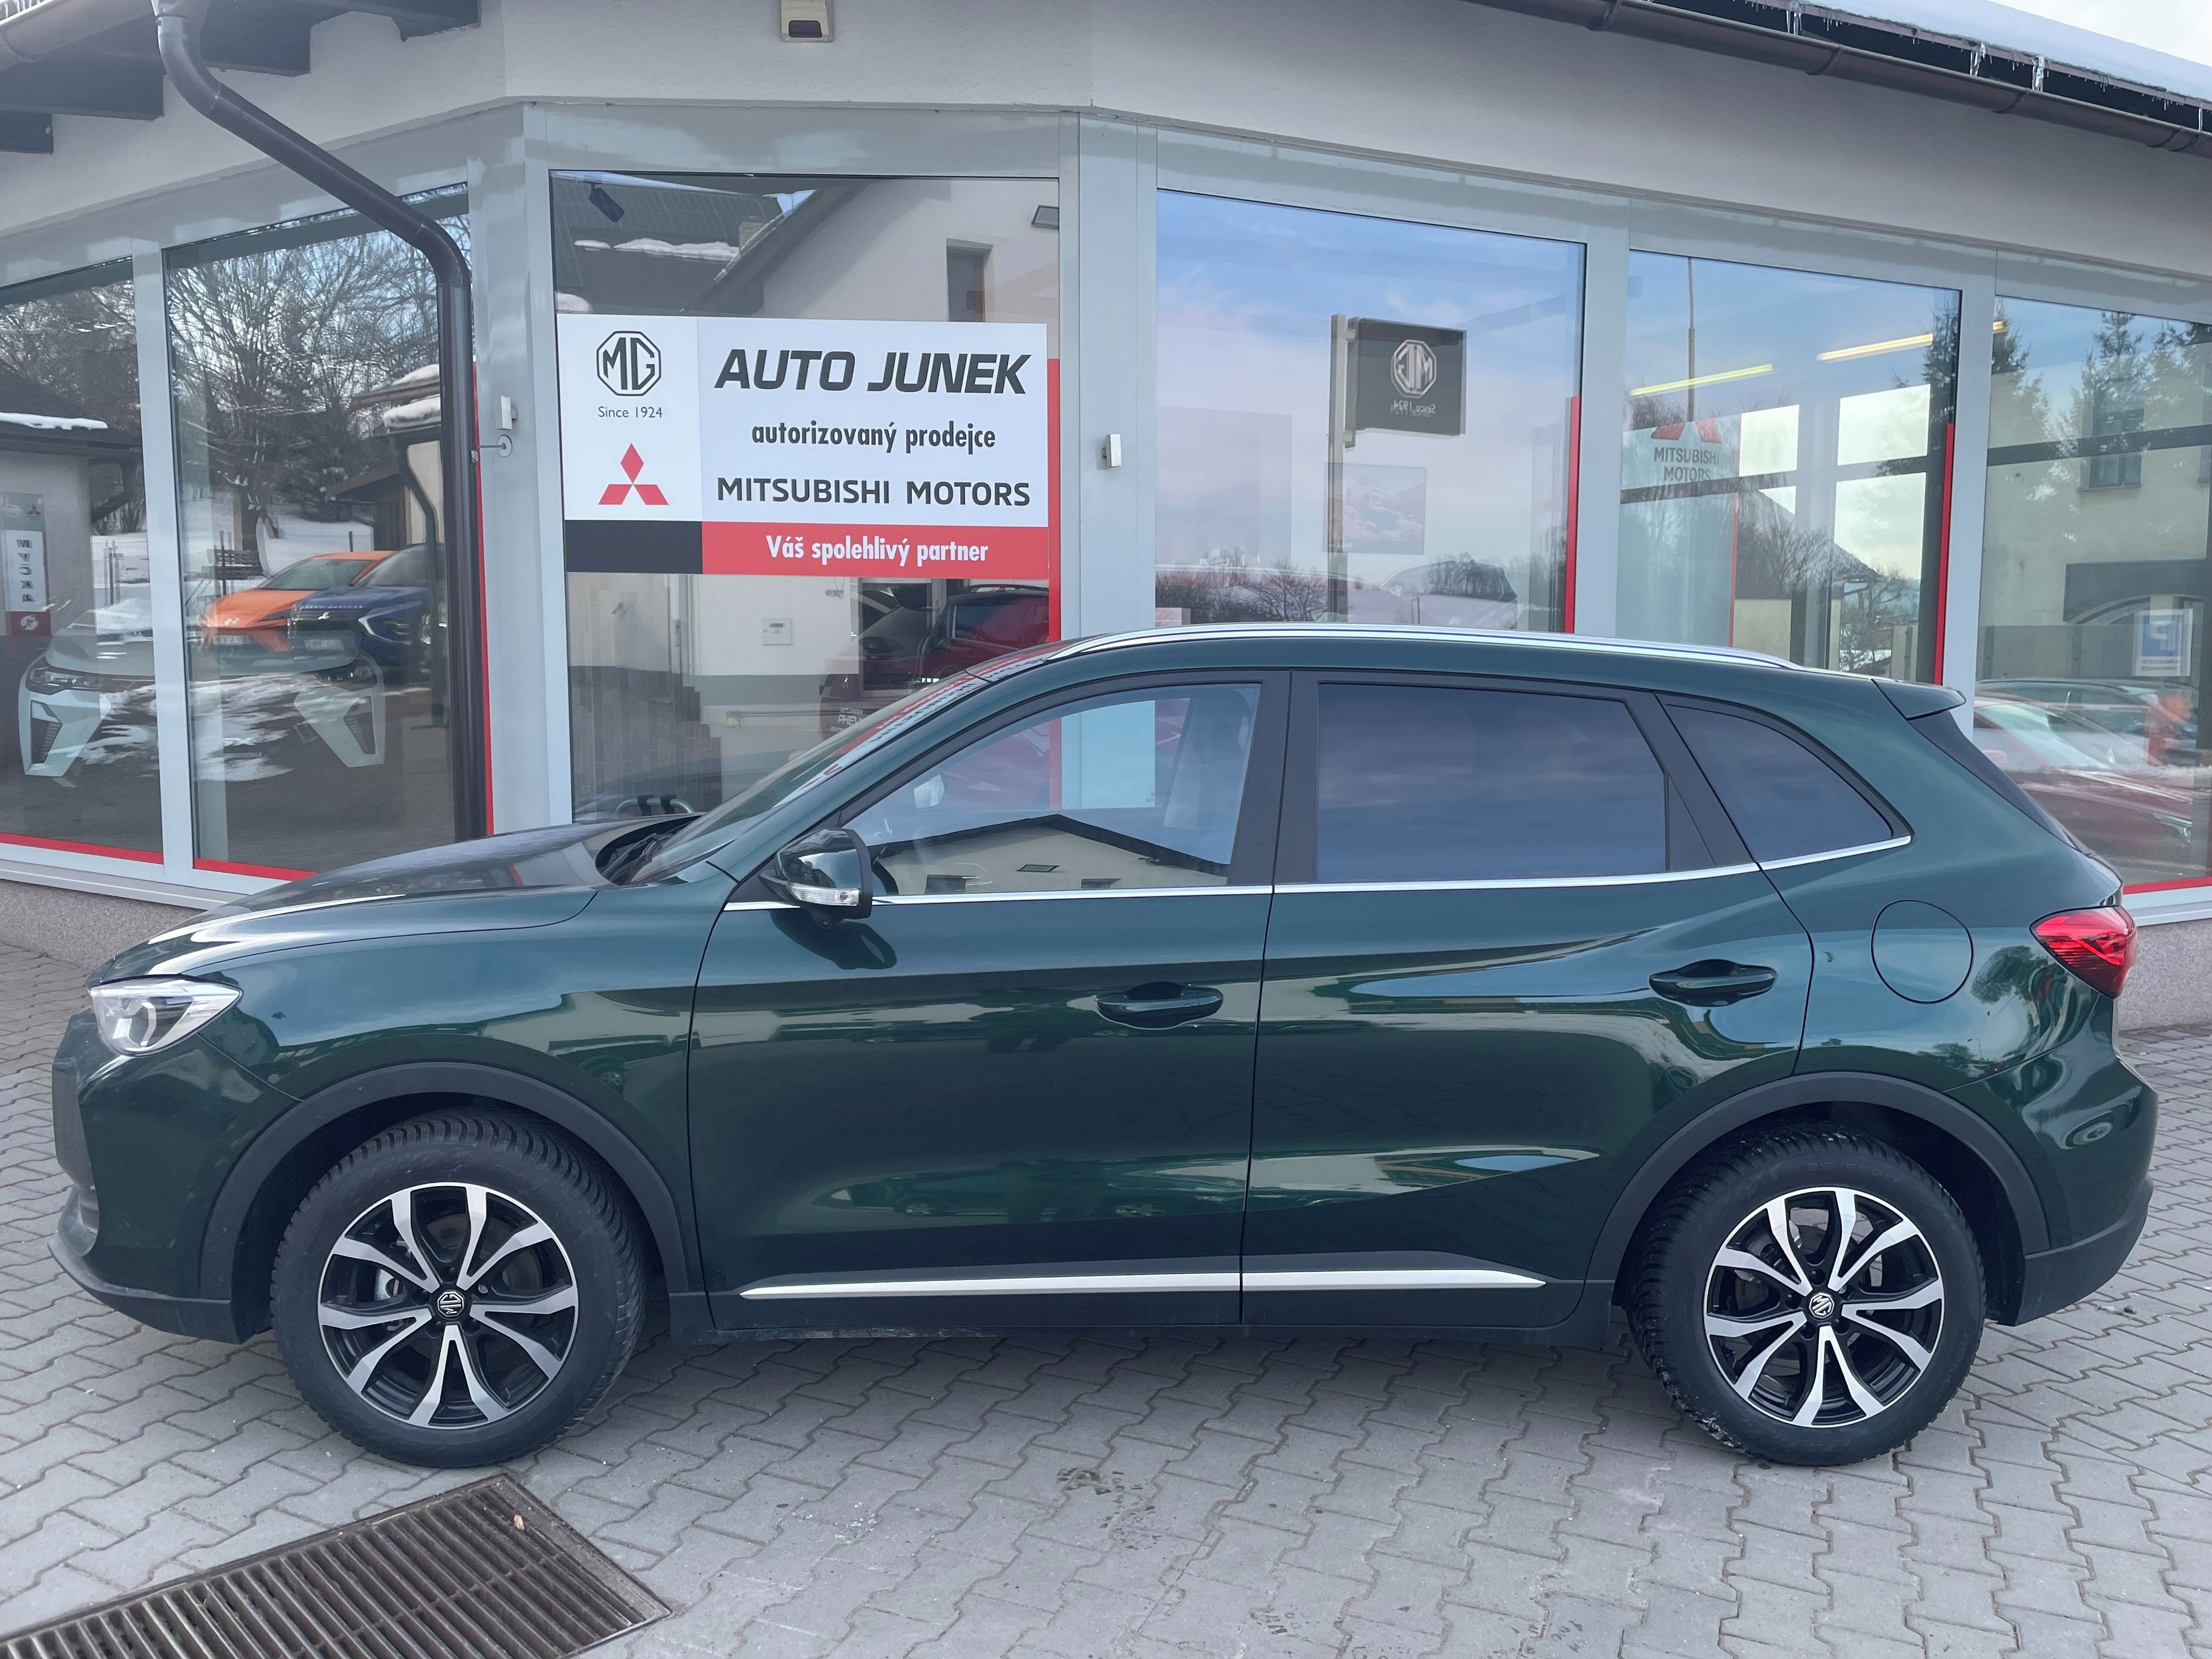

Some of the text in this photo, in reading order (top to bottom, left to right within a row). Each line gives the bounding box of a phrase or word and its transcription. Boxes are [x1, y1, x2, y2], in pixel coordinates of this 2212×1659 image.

[602, 336, 657, 391] MG
[714, 348, 1032, 394] AUTO JUNEK
[598, 406, 663, 418] Since 1924
[752, 420, 996, 455] autorizovaný prodejce
[1654, 447, 1719, 466] MITSUBISHI
[1663, 466, 1711, 482] MOTORS
[718, 477, 1030, 506] MITSUBISHI MOTORS
[765, 535, 989, 567] Váš spolehlivý partner
[1811, 1295, 1833, 1316] MG
